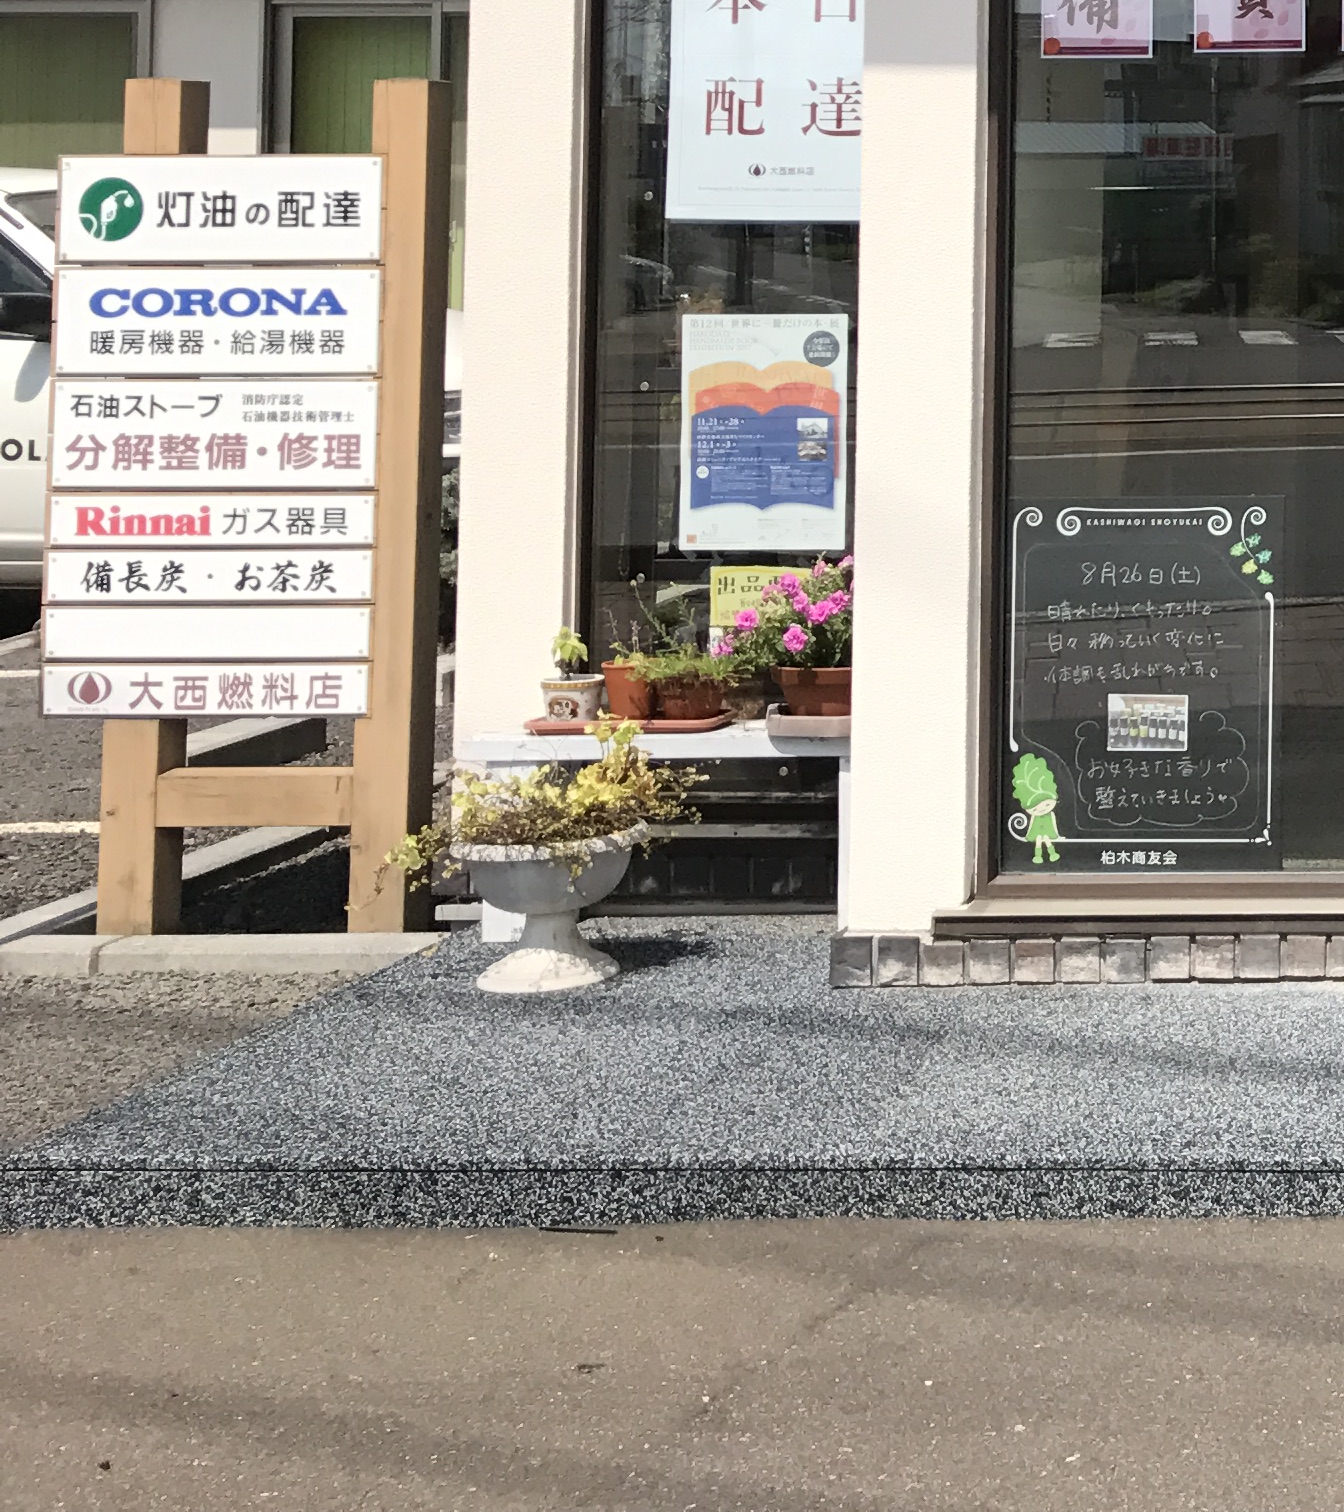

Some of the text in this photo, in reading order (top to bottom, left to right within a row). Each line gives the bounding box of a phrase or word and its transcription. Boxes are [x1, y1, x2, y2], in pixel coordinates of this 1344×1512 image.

[704, 76, 863, 137] 配達
[156, 190, 363, 230] 灯油の配達
[89, 287, 348, 317] CORONA
[89, 330, 346, 355] 暖房機器・給湯機器
[70, 393, 223, 419] 石油ストーブ
[0, 439, 47, 461] OL
[64, 431, 363, 472] 分解整備・修理
[75, 506, 349, 537] Rinnai ガス器具
[1086, 518, 1203, 526] KASHIWAGI SHOYUKAI
[1081, 561, 1201, 587] 8月26日(土)
[129, 672, 343, 710] 大西燃料店
[1100, 849, 1178, 865] 柏木商友会
